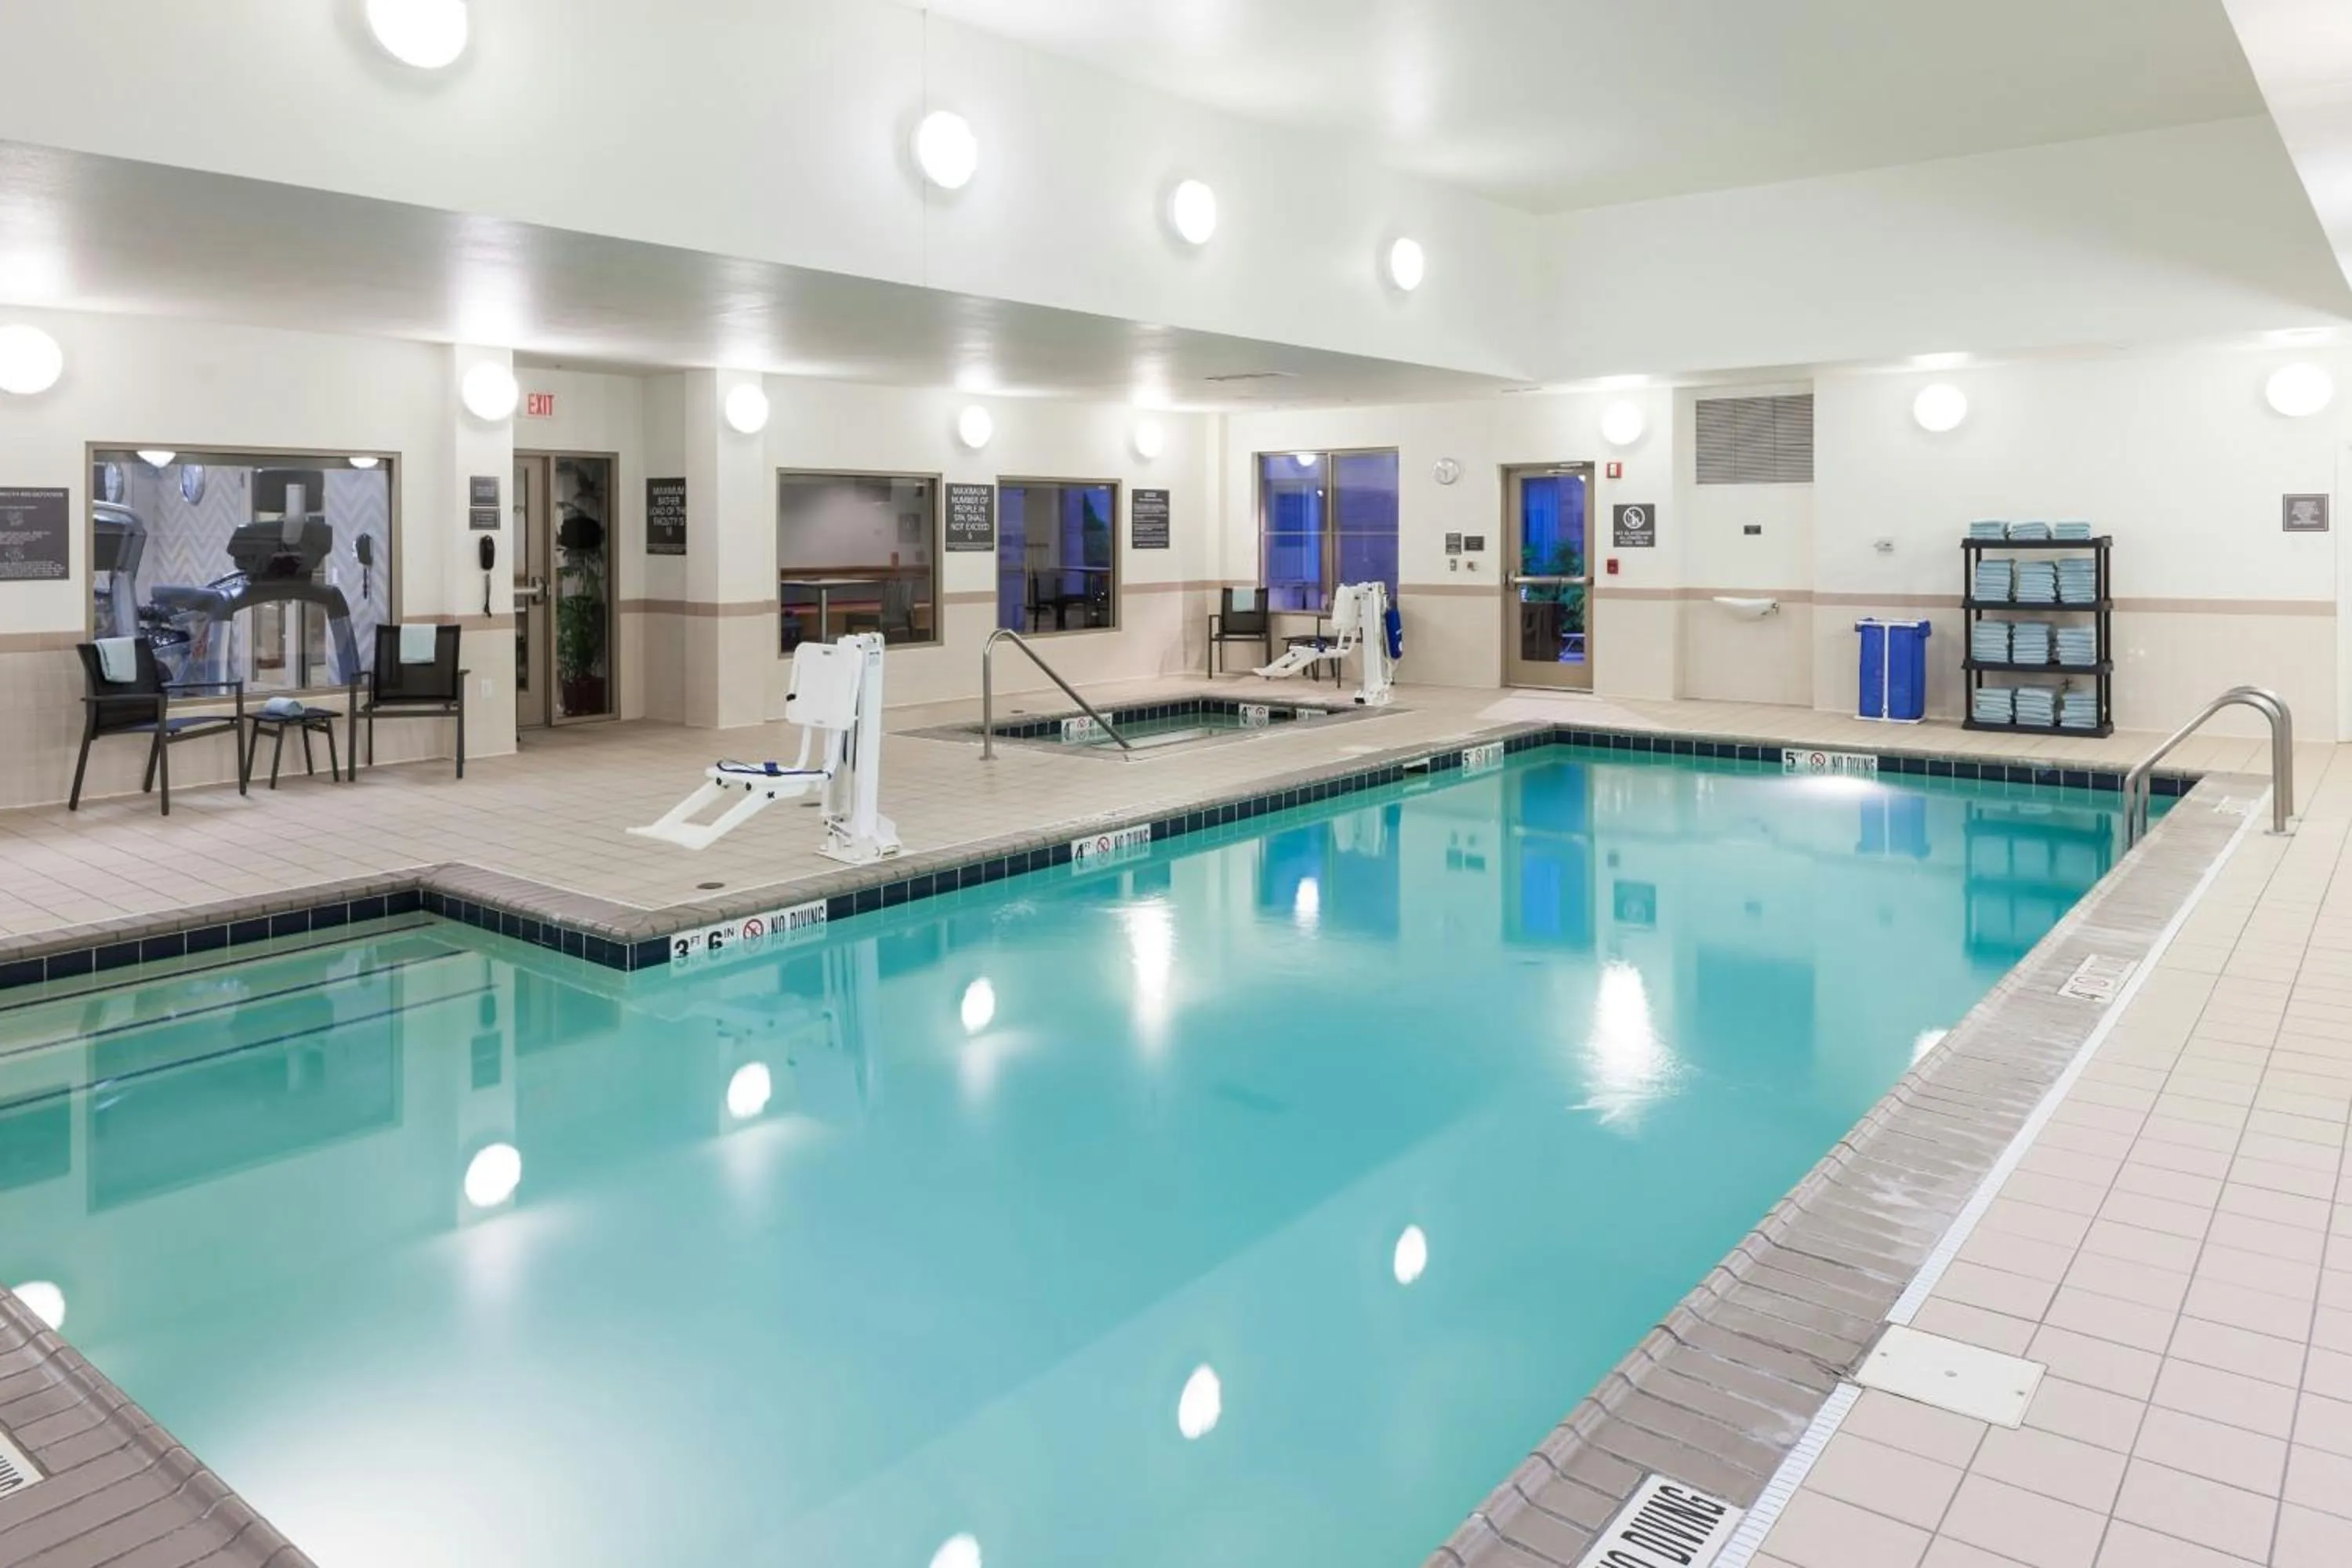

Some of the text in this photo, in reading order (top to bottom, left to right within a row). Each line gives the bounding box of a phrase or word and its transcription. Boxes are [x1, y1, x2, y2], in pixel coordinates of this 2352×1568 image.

[528, 393, 554, 416] EXIT
[954, 504, 977, 513] PEOPLE
[951, 522, 964, 531] NOT
[1785, 752, 1795, 765] 5
[674, 906, 825, 958] 3 FT 6 IN NO DIVING
[1595, 1485, 1726, 1568] O DIVING
